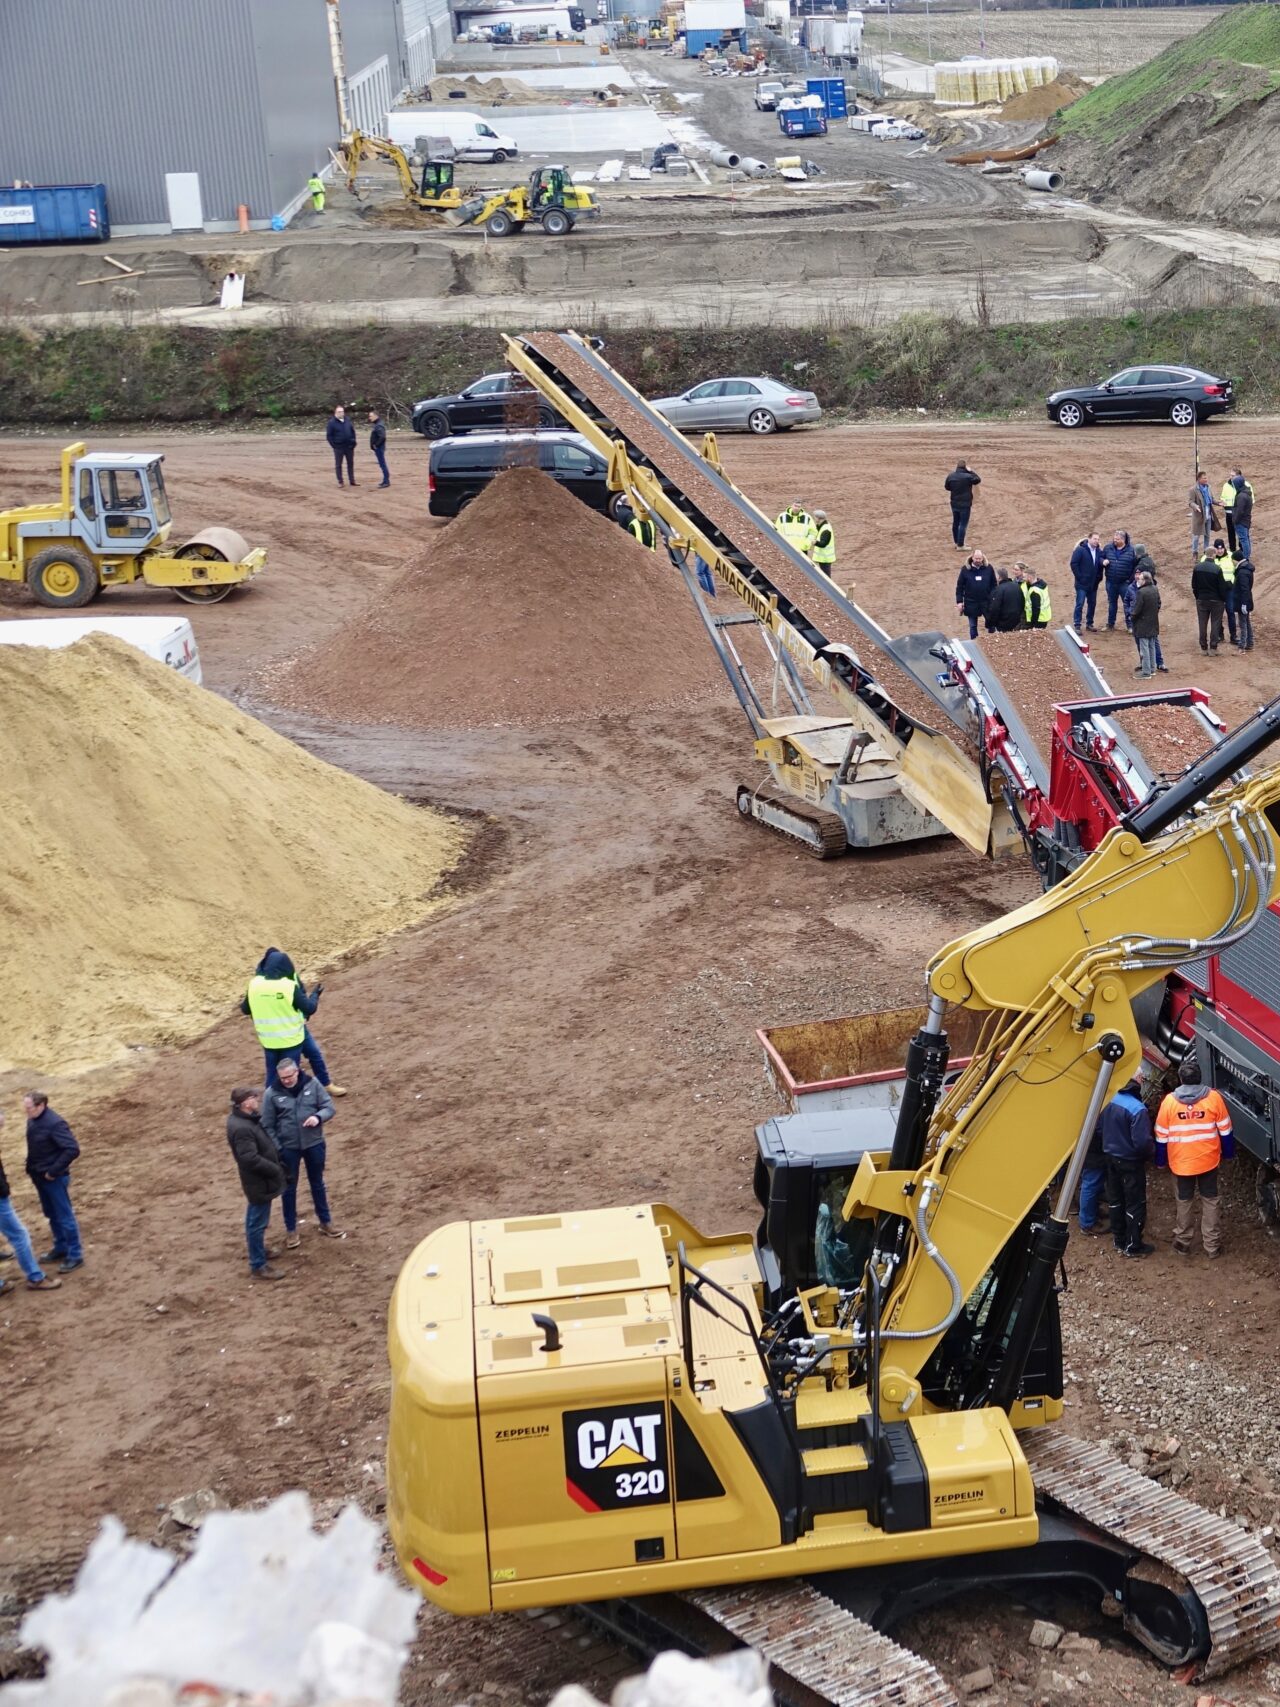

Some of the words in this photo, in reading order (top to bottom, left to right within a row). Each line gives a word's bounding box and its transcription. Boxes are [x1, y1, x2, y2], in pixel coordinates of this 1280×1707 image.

[714, 557, 774, 629] ANACONDA
[495, 1424, 550, 1439] ZEPPELIN
[577, 1414, 662, 1469] CAT
[615, 1469, 665, 1498] 320
[934, 1489, 984, 1504] ZEPPELIN
